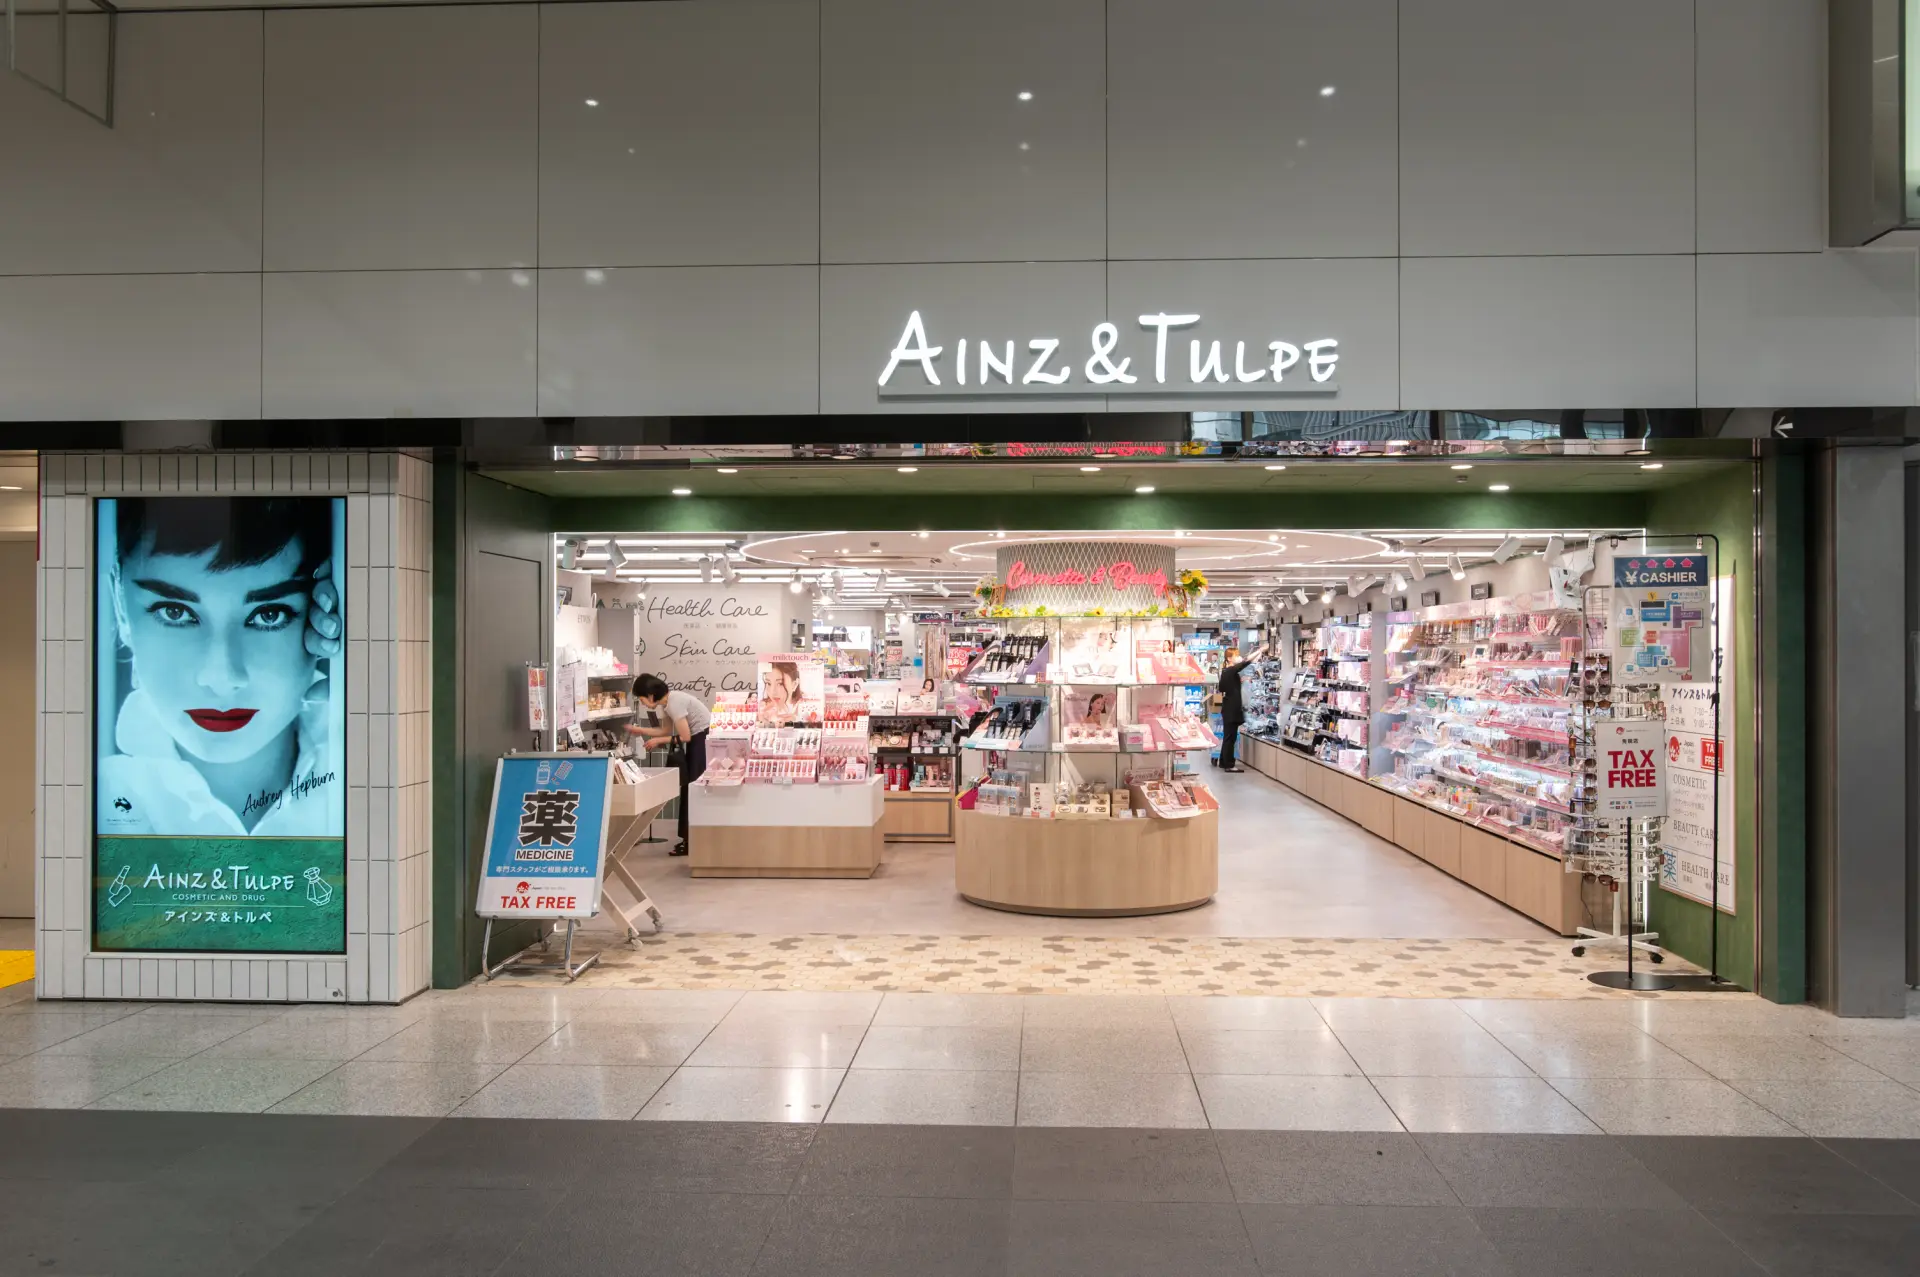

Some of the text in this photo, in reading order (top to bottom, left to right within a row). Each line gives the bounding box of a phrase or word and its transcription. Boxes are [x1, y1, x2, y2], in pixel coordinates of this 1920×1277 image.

[1639, 571, 1698, 583] CASHIER
[647, 597, 768, 623] Health Care
[659, 633, 756, 660] Skin Care
[1607, 749, 1655, 769] TAX
[1608, 769, 1656, 789] FREE
[1673, 773, 1708, 790] COSMETIC
[242, 771, 336, 817] Audrey Hepburn
[516, 789, 581, 847] 薬
[1673, 820, 1699, 837] BEAUTY
[516, 850, 573, 860] MEDICINE
[1663, 850, 1677, 882] 薬
[1681, 860, 1710, 880] HEALTH
[172, 893, 266, 902] COSMETIC AND DRUG
[500, 895, 577, 909] TAX FREE
[164, 910, 273, 924] アインズ&トルペ
